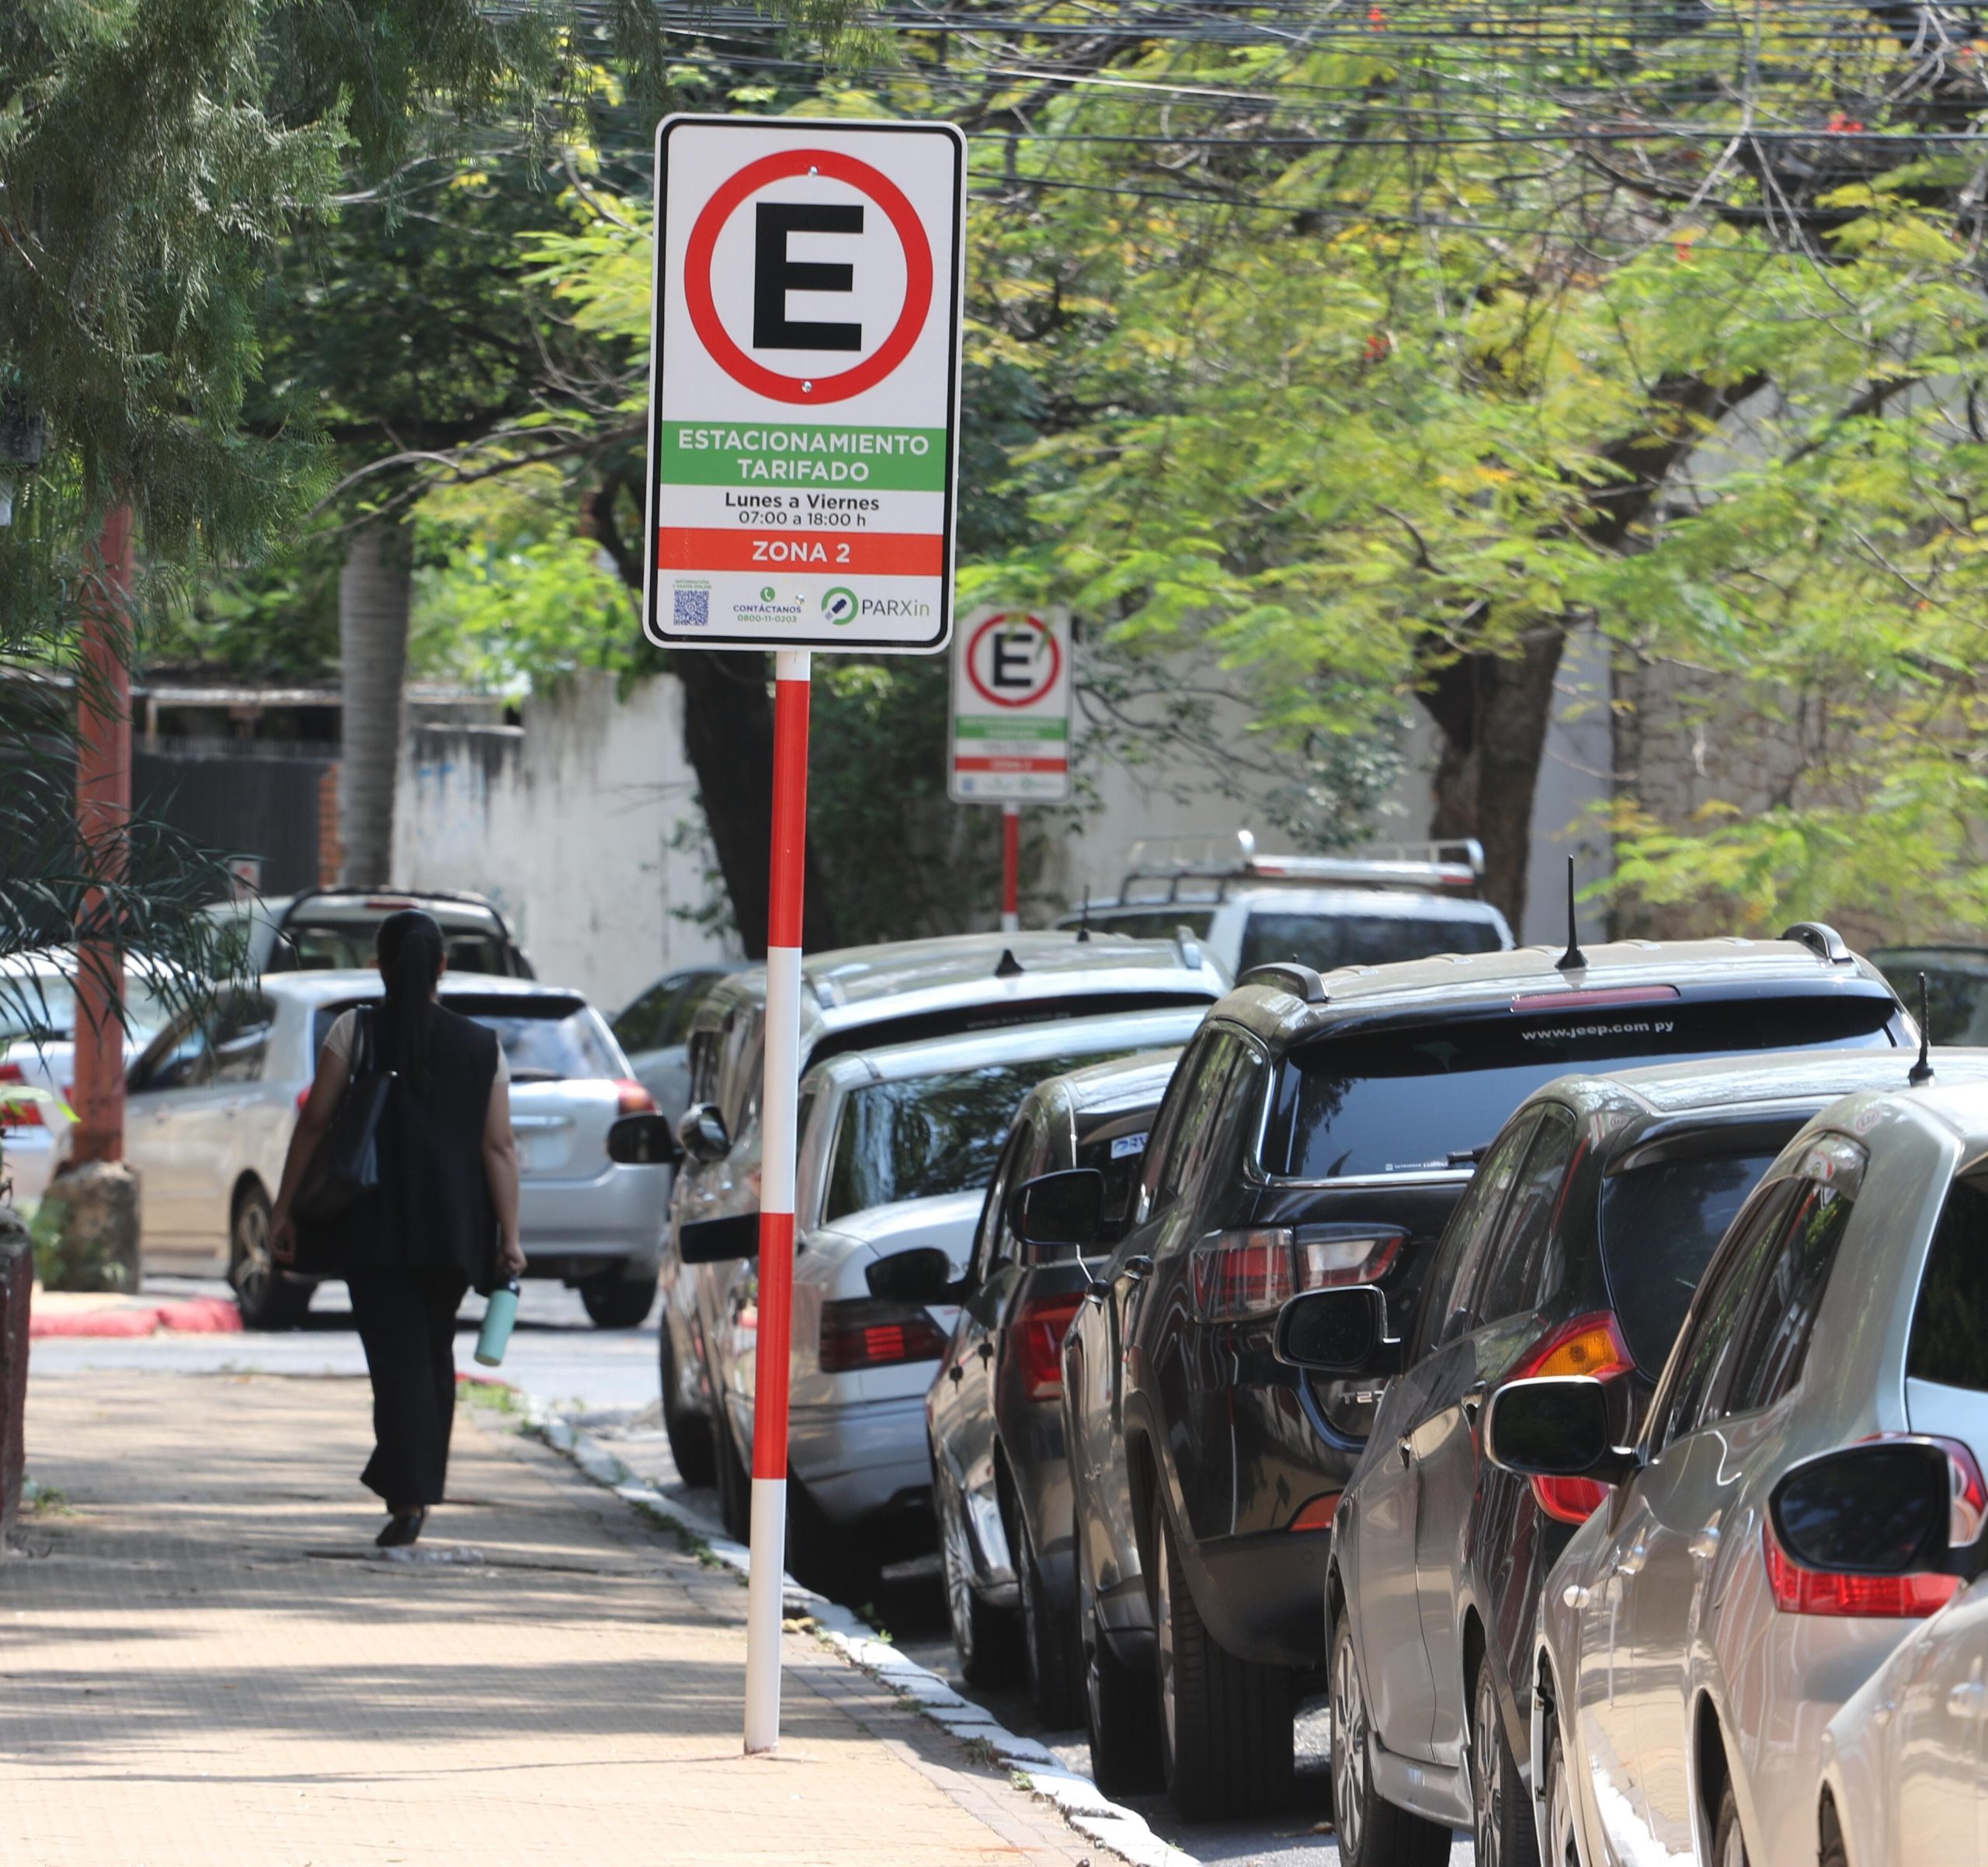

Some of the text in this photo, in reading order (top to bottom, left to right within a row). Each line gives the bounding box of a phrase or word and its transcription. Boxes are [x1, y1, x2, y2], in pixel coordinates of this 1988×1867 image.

[753, 202, 864, 351] E
[678, 429, 930, 456] ESTACIONAMIENTO
[738, 459, 870, 482] TARIFADO
[725, 492, 880, 510] Lunes a Viernes
[739, 511, 866, 527] 07:00 a 18:00 h
[752, 541, 851, 563] ZONA 2
[733, 604, 801, 614] CONTÁCTANOS
[861, 599, 930, 617] PARXin
[738, 614, 797, 623] 0800-11-0203
[992, 633, 1034, 687] E
[1521, 1022, 1649, 1040] www.jeep.com
